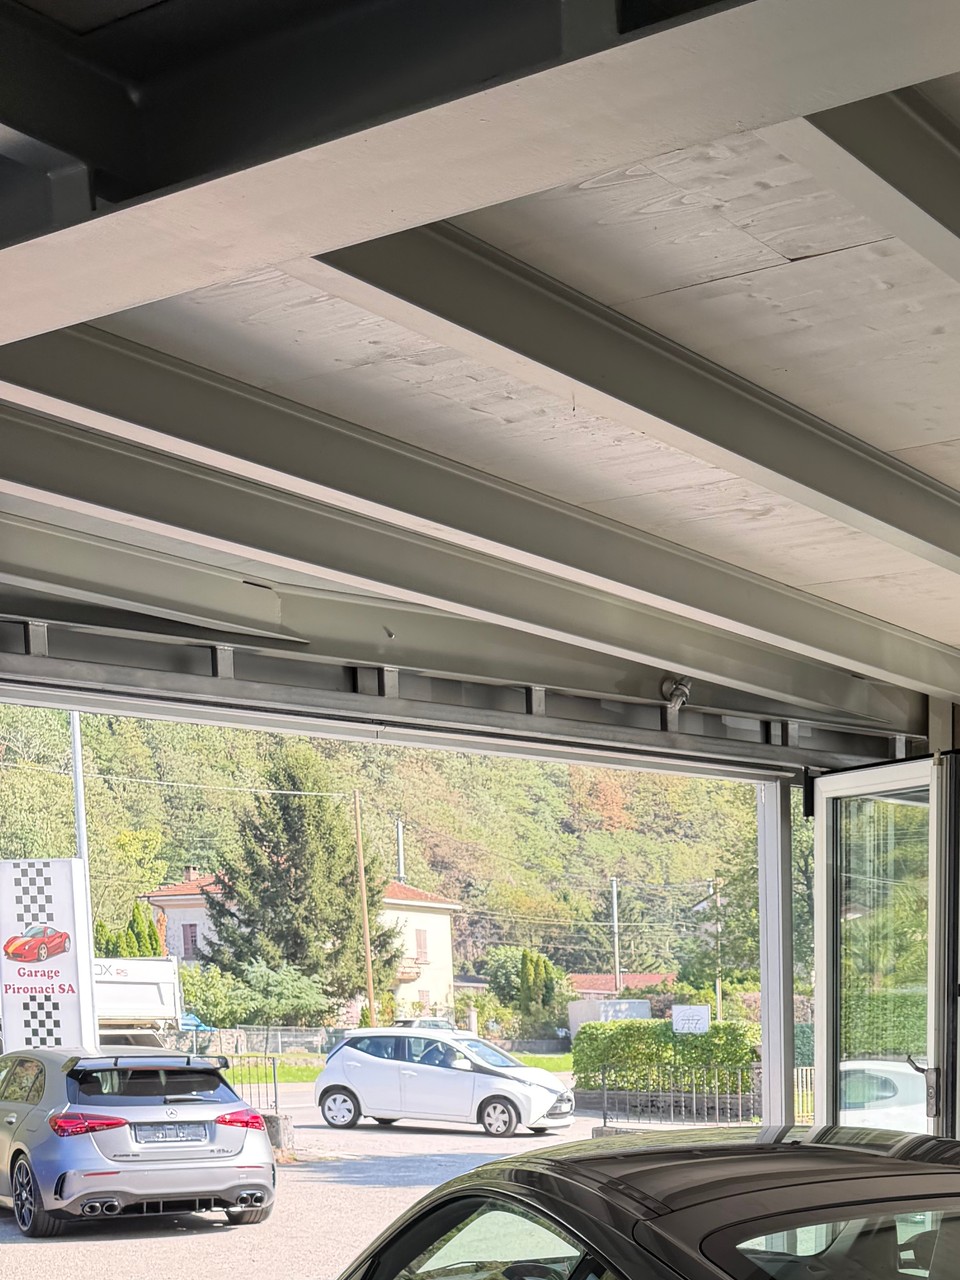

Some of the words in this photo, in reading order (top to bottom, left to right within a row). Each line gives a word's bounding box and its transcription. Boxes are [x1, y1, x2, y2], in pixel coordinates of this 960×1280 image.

[17, 967, 60, 980] Garage
[4, 984, 55, 994] Pironaci
[58, 984, 76, 994] SA
